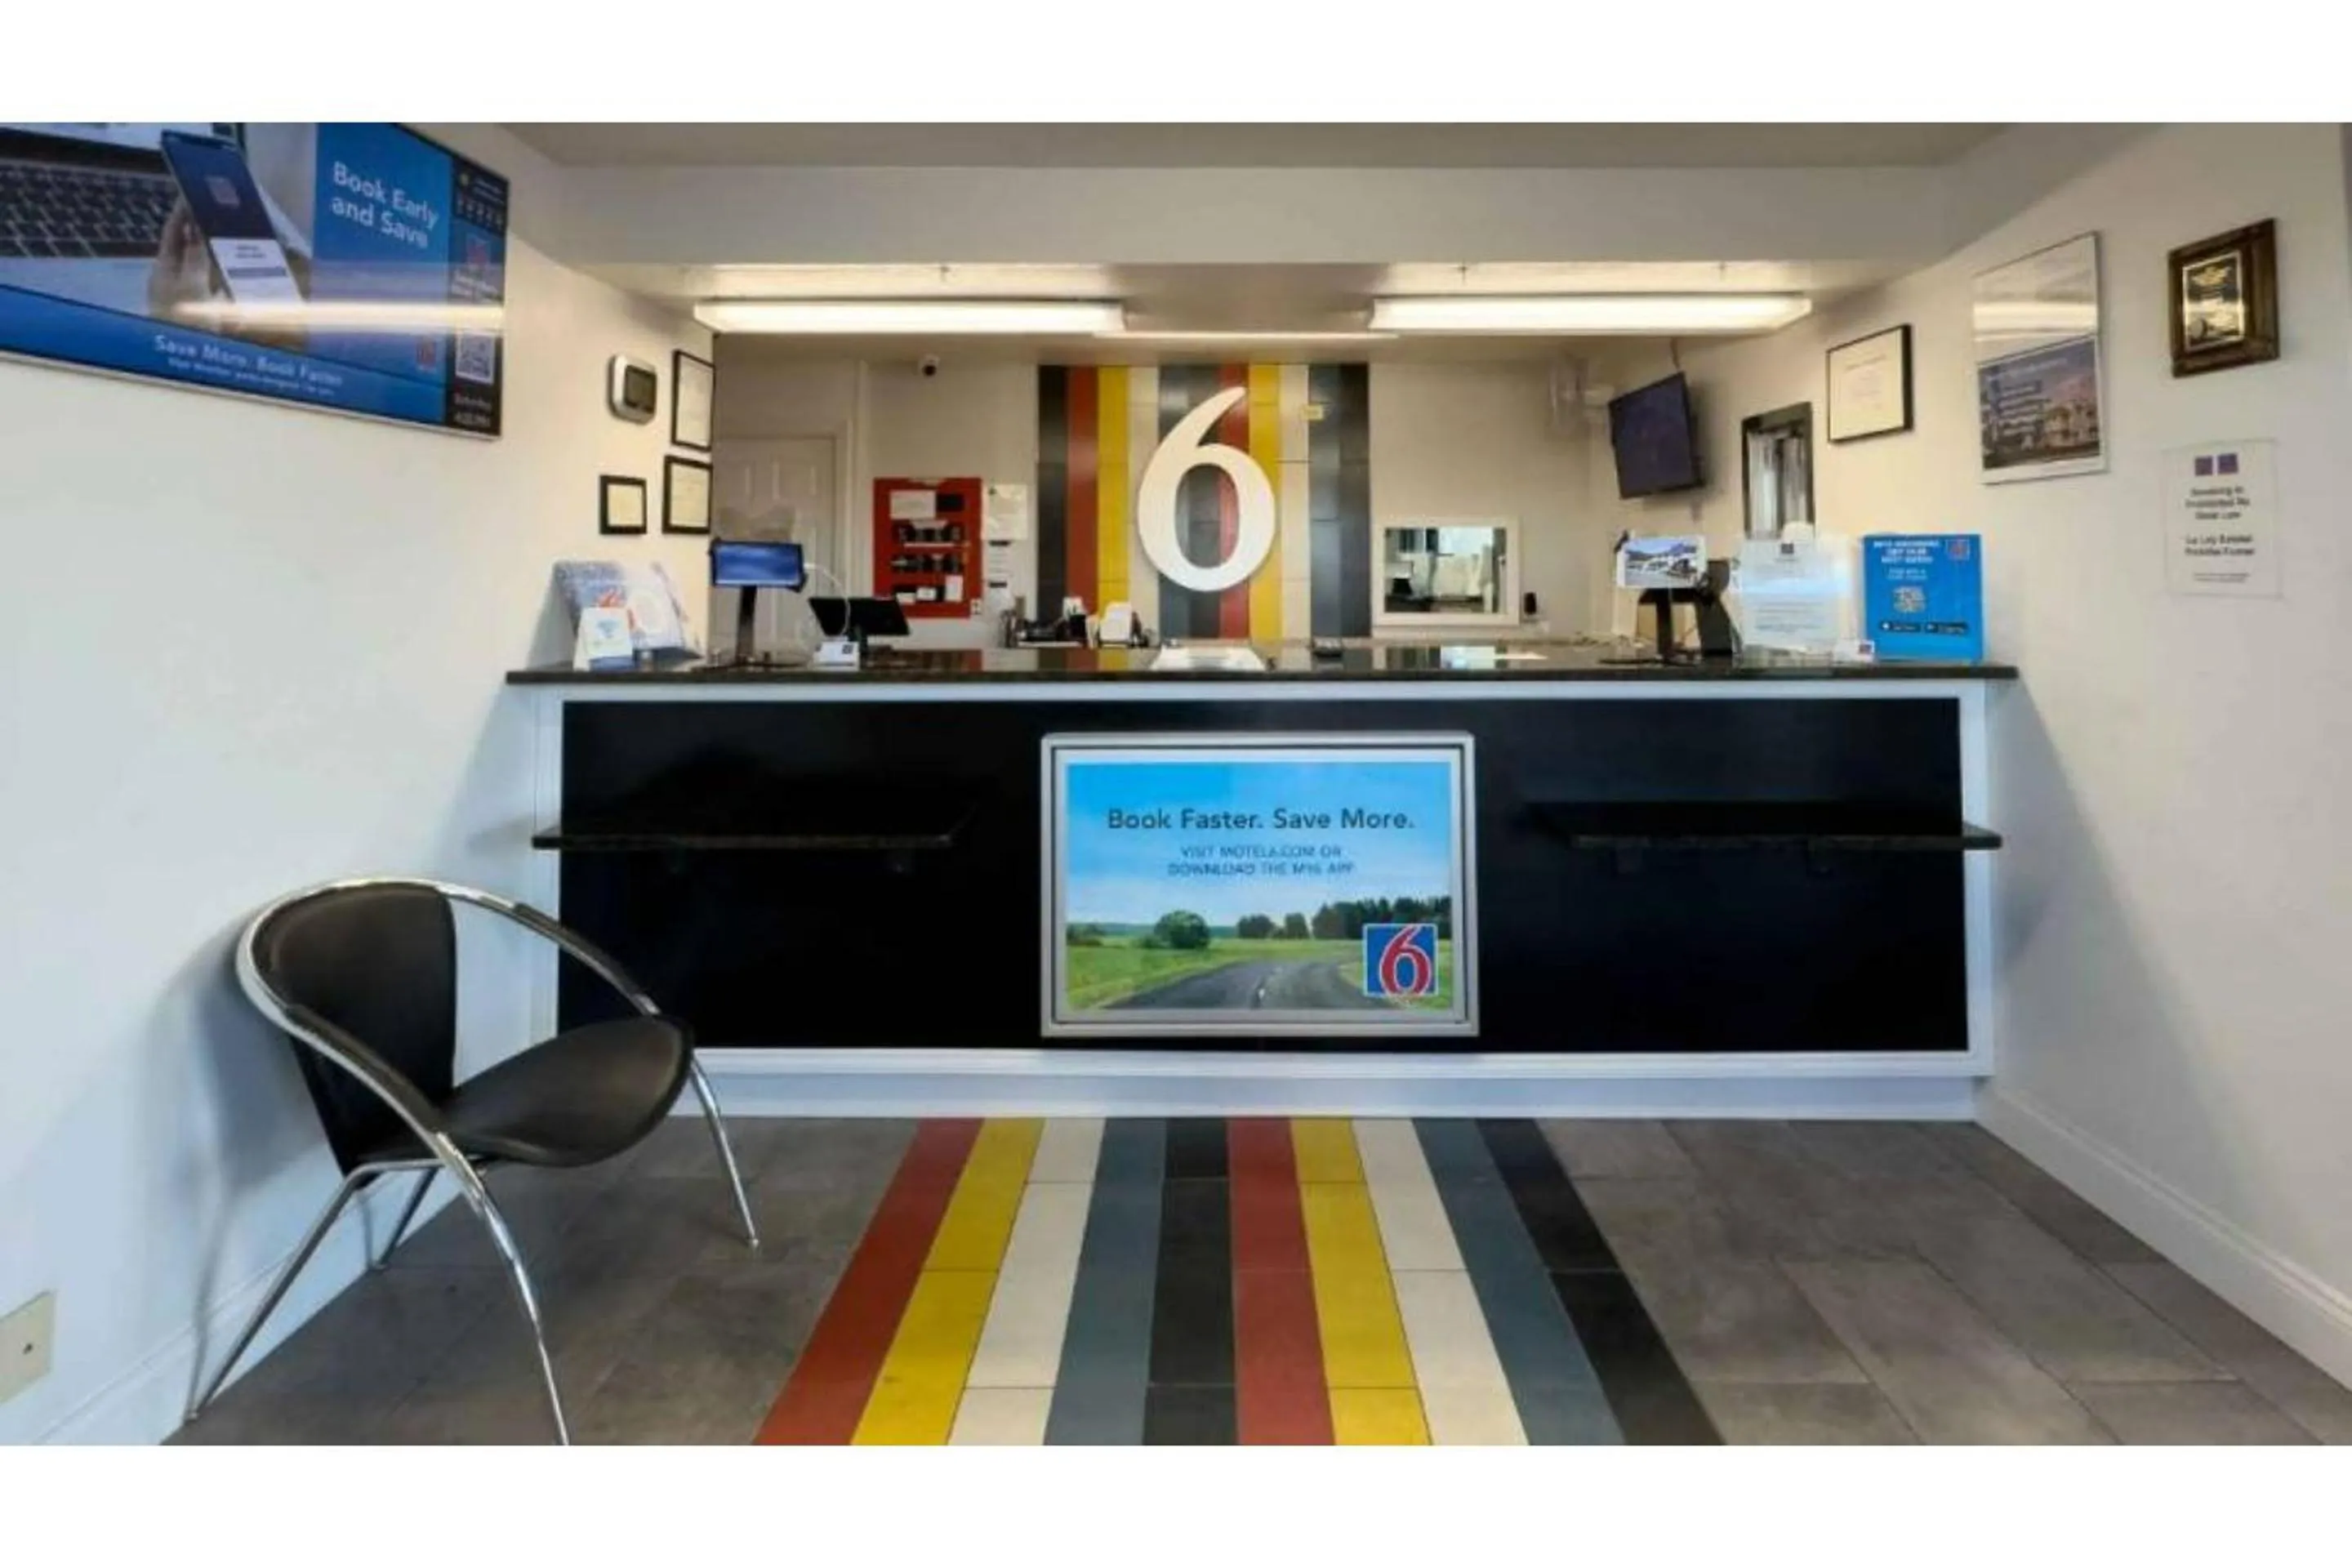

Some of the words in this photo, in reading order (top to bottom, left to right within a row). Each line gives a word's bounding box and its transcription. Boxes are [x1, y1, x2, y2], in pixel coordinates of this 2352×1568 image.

[332, 196, 375, 227] and
[381, 210, 429, 250] Save
[333, 161, 386, 203] Book
[392, 187, 440, 232] Early
[1138, 385, 1276, 592] 6
[1107, 807, 1172, 830] Book
[1180, 808, 1263, 830] Faster.
[1273, 807, 1331, 830] Save
[1340, 807, 1416, 830] More.
[1167, 862, 1256, 876] DOWNLOAD
[1261, 862, 1288, 876] THE
[1180, 844, 1214, 858] VISIT
[1319, 844, 1342, 858] OR
[1379, 924, 1432, 998] 6
